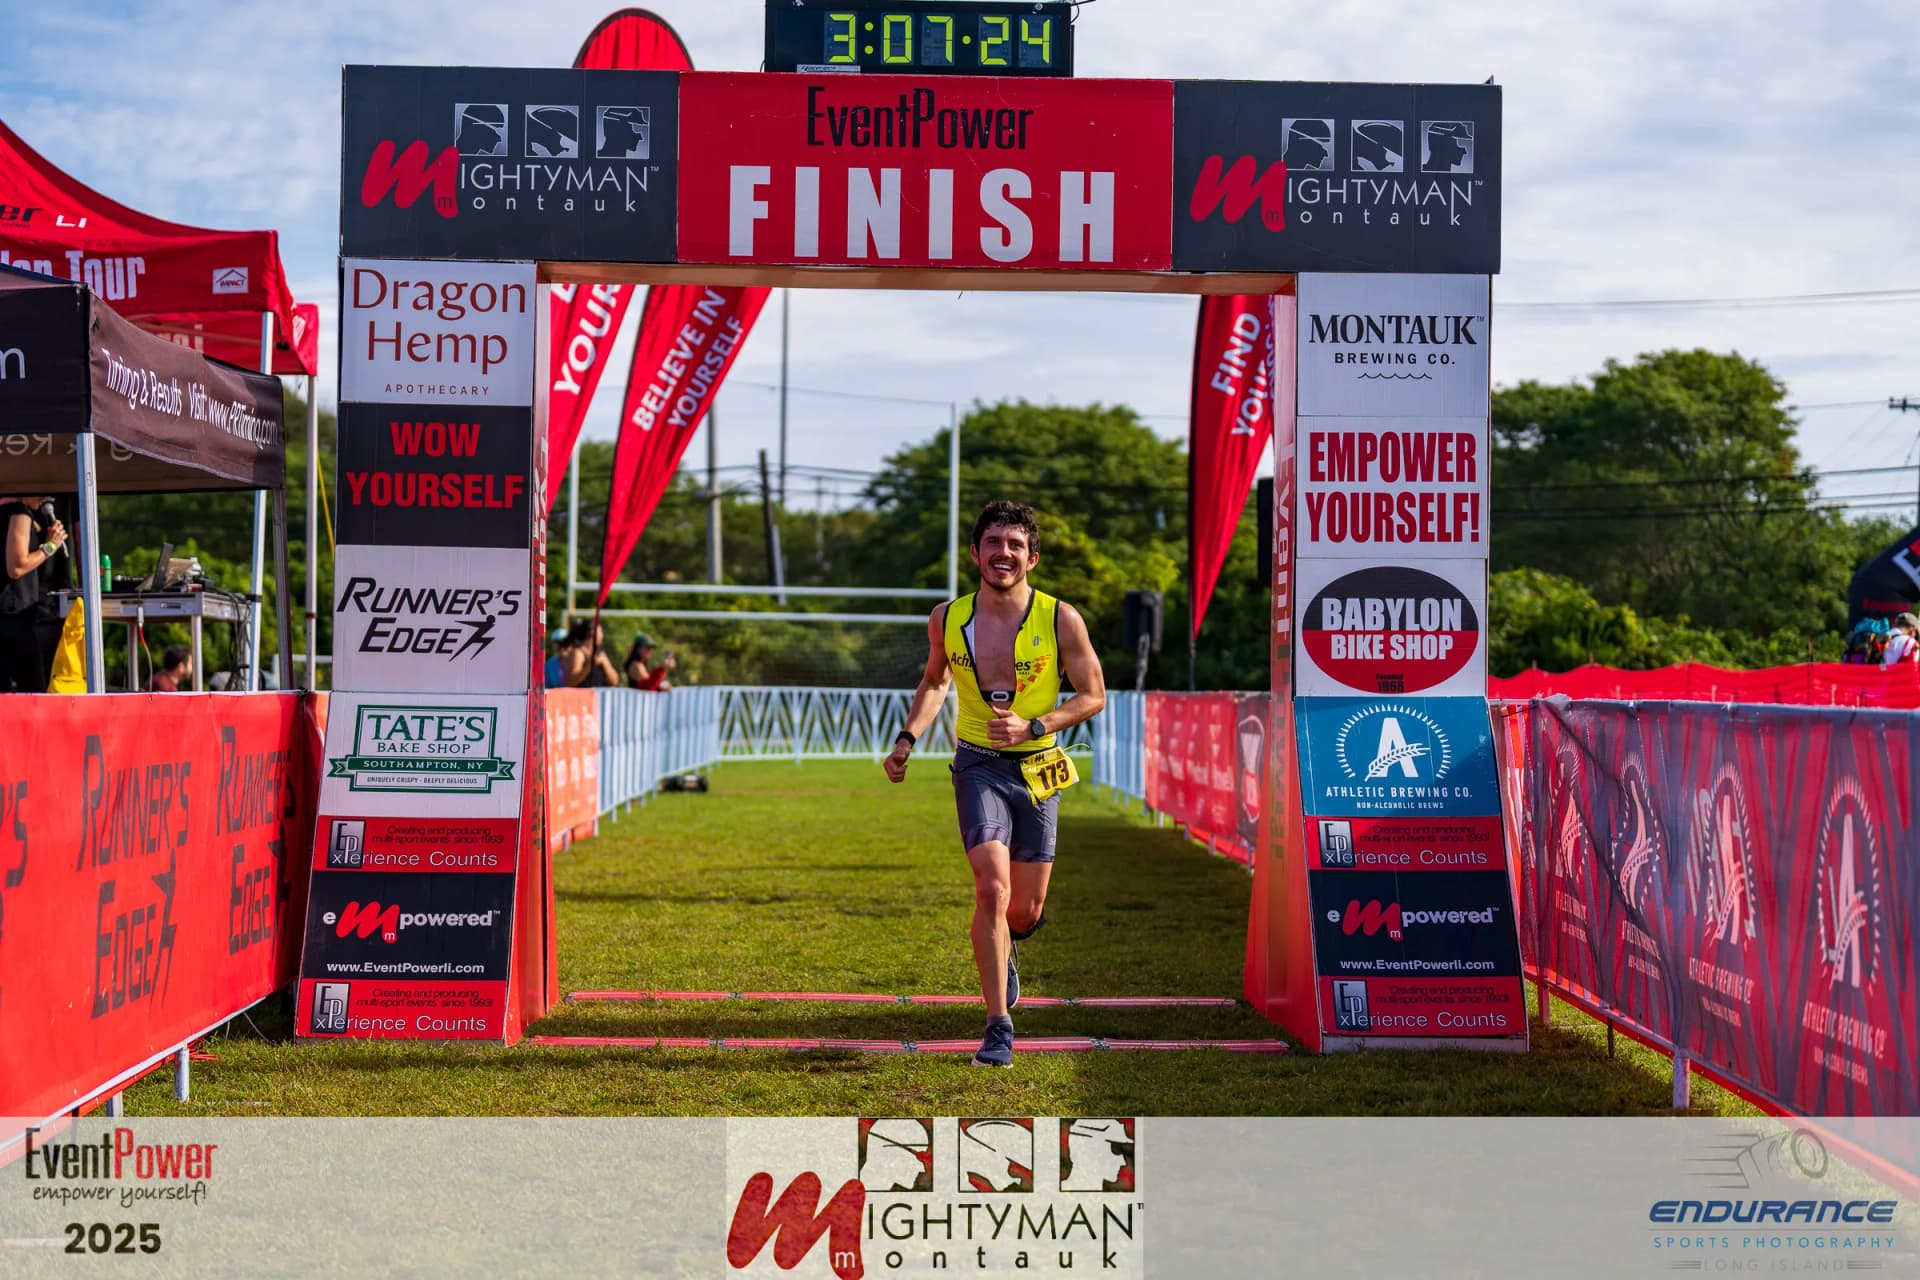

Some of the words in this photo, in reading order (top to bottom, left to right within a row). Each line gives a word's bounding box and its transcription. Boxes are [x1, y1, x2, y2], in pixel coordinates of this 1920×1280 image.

[807, 86, 1034, 150] EventPower
[729, 165, 1115, 263] FINISH
[66, 250, 146, 301] Tour
[353, 268, 526, 321] Dragon
[1309, 314, 1477, 344] MONTAUK
[368, 321, 508, 375] Hemp
[632, 323, 705, 433] BELIEVE
[692, 289, 727, 327] IN
[1211, 313, 1261, 397] FIND
[1335, 353, 1417, 364] BREWING
[1428, 353, 1455, 364] CO.
[102, 348, 137, 410] Timing
[141, 369, 149, 406] &
[150, 371, 182, 417] Results
[385, 384, 489, 396] APOTHECARY
[667, 316, 744, 428] YOURSELF
[390, 422, 481, 457] WOW
[1310, 432, 1476, 483] EMPOWER
[346, 472, 524, 508] YOURSELF
[1305, 492, 1480, 543] YOURSELF!
[336, 577, 523, 616] RUNNER'S
[1322, 598, 1462, 631] BABYLON
[358, 617, 463, 654] EDGE
[1331, 634, 1384, 660] BIKE
[1390, 634, 1454, 660] SHOP
[367, 714, 485, 743] TATE'S
[363, 760, 460, 770] SOUTHAMPTON,
[467, 761, 483, 769] NY
[377, 742, 420, 753] BAKE
[427, 743, 471, 754] SHOP
[216, 726, 297, 837] RUNNER'S
[1037, 760, 1070, 791] 173
[1326, 786, 1385, 797] ATHLETIC
[1391, 786, 1449, 797] BREWING
[1454, 786, 1473, 797] CO.
[76, 735, 191, 872] RUNNER'S
[429, 851, 498, 866] Counts
[1419, 850, 1488, 865] Counts
[228, 844, 270, 957] EDGE
[90, 879, 156, 1019] EDGE
[1340, 960, 1494, 971] www.EventPowerli.com
[327, 962, 485, 974] www.EventPowerli.com
[416, 1016, 486, 1031] Counts
[1437, 1011, 1507, 1028] Counts
